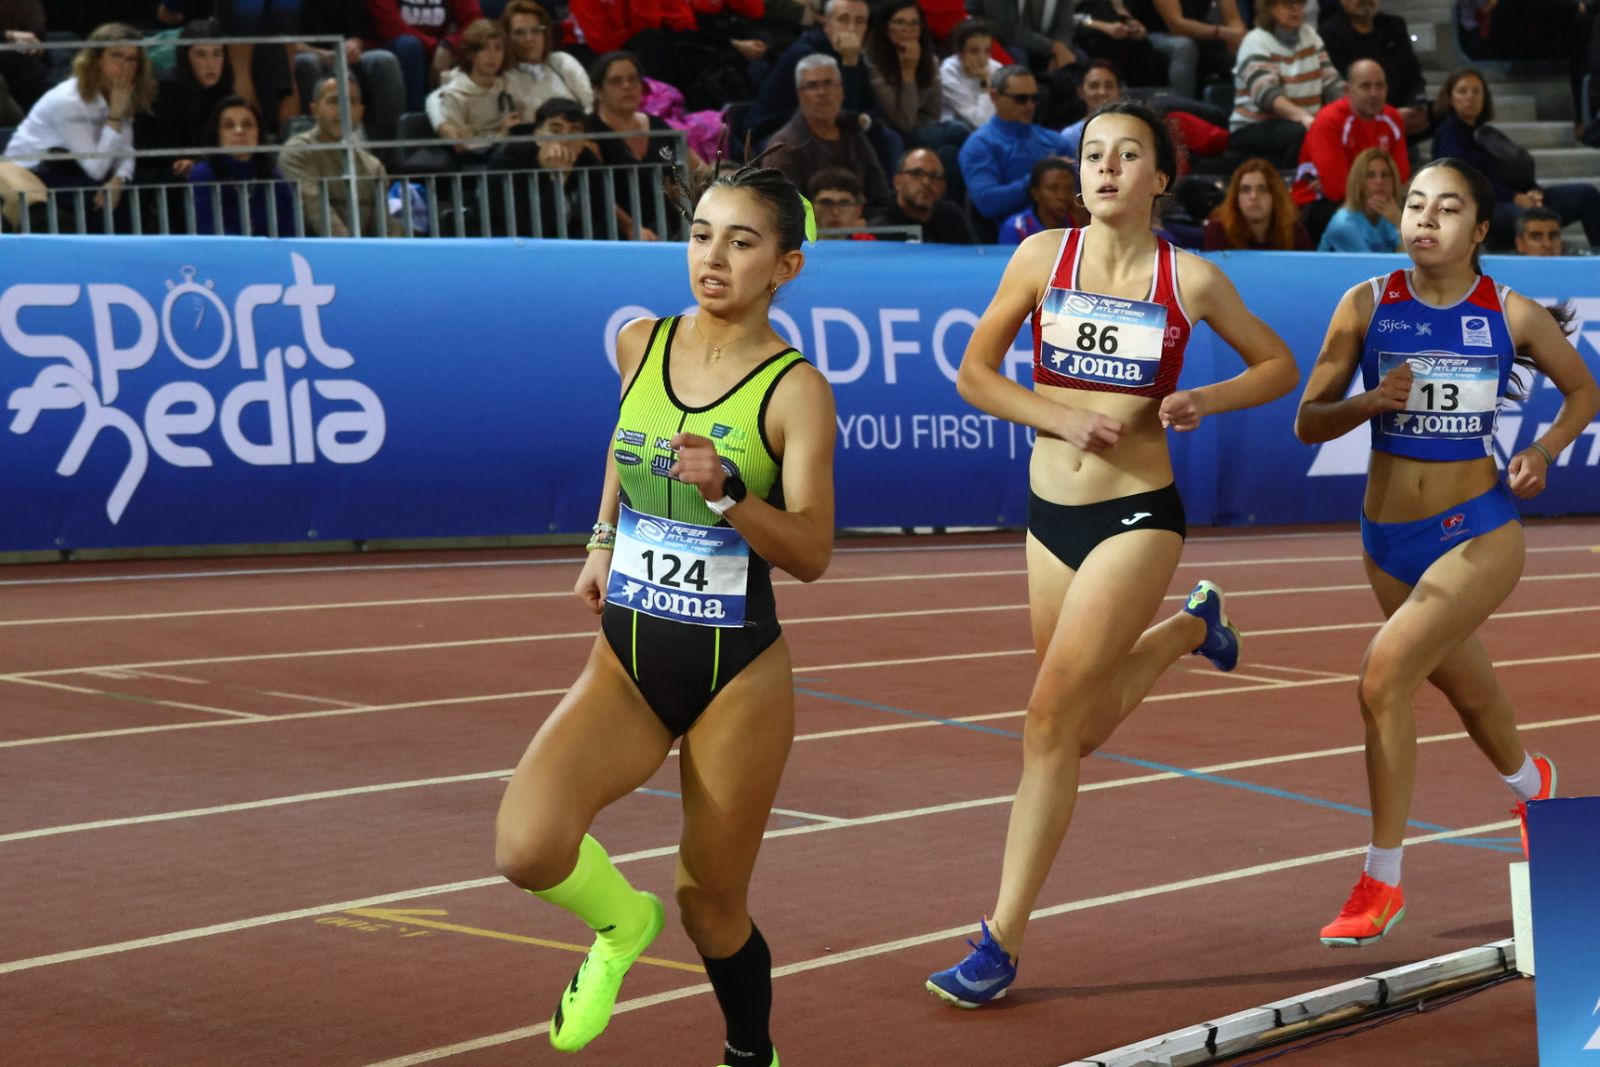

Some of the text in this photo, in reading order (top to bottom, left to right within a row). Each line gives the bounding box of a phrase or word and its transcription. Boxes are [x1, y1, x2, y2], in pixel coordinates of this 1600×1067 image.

[1076, 322, 1119, 354] 86
[1420, 383, 1460, 411] 13
[836, 414, 901, 449] YOU
[912, 415, 999, 448] FIRST
[641, 549, 709, 592] 124
